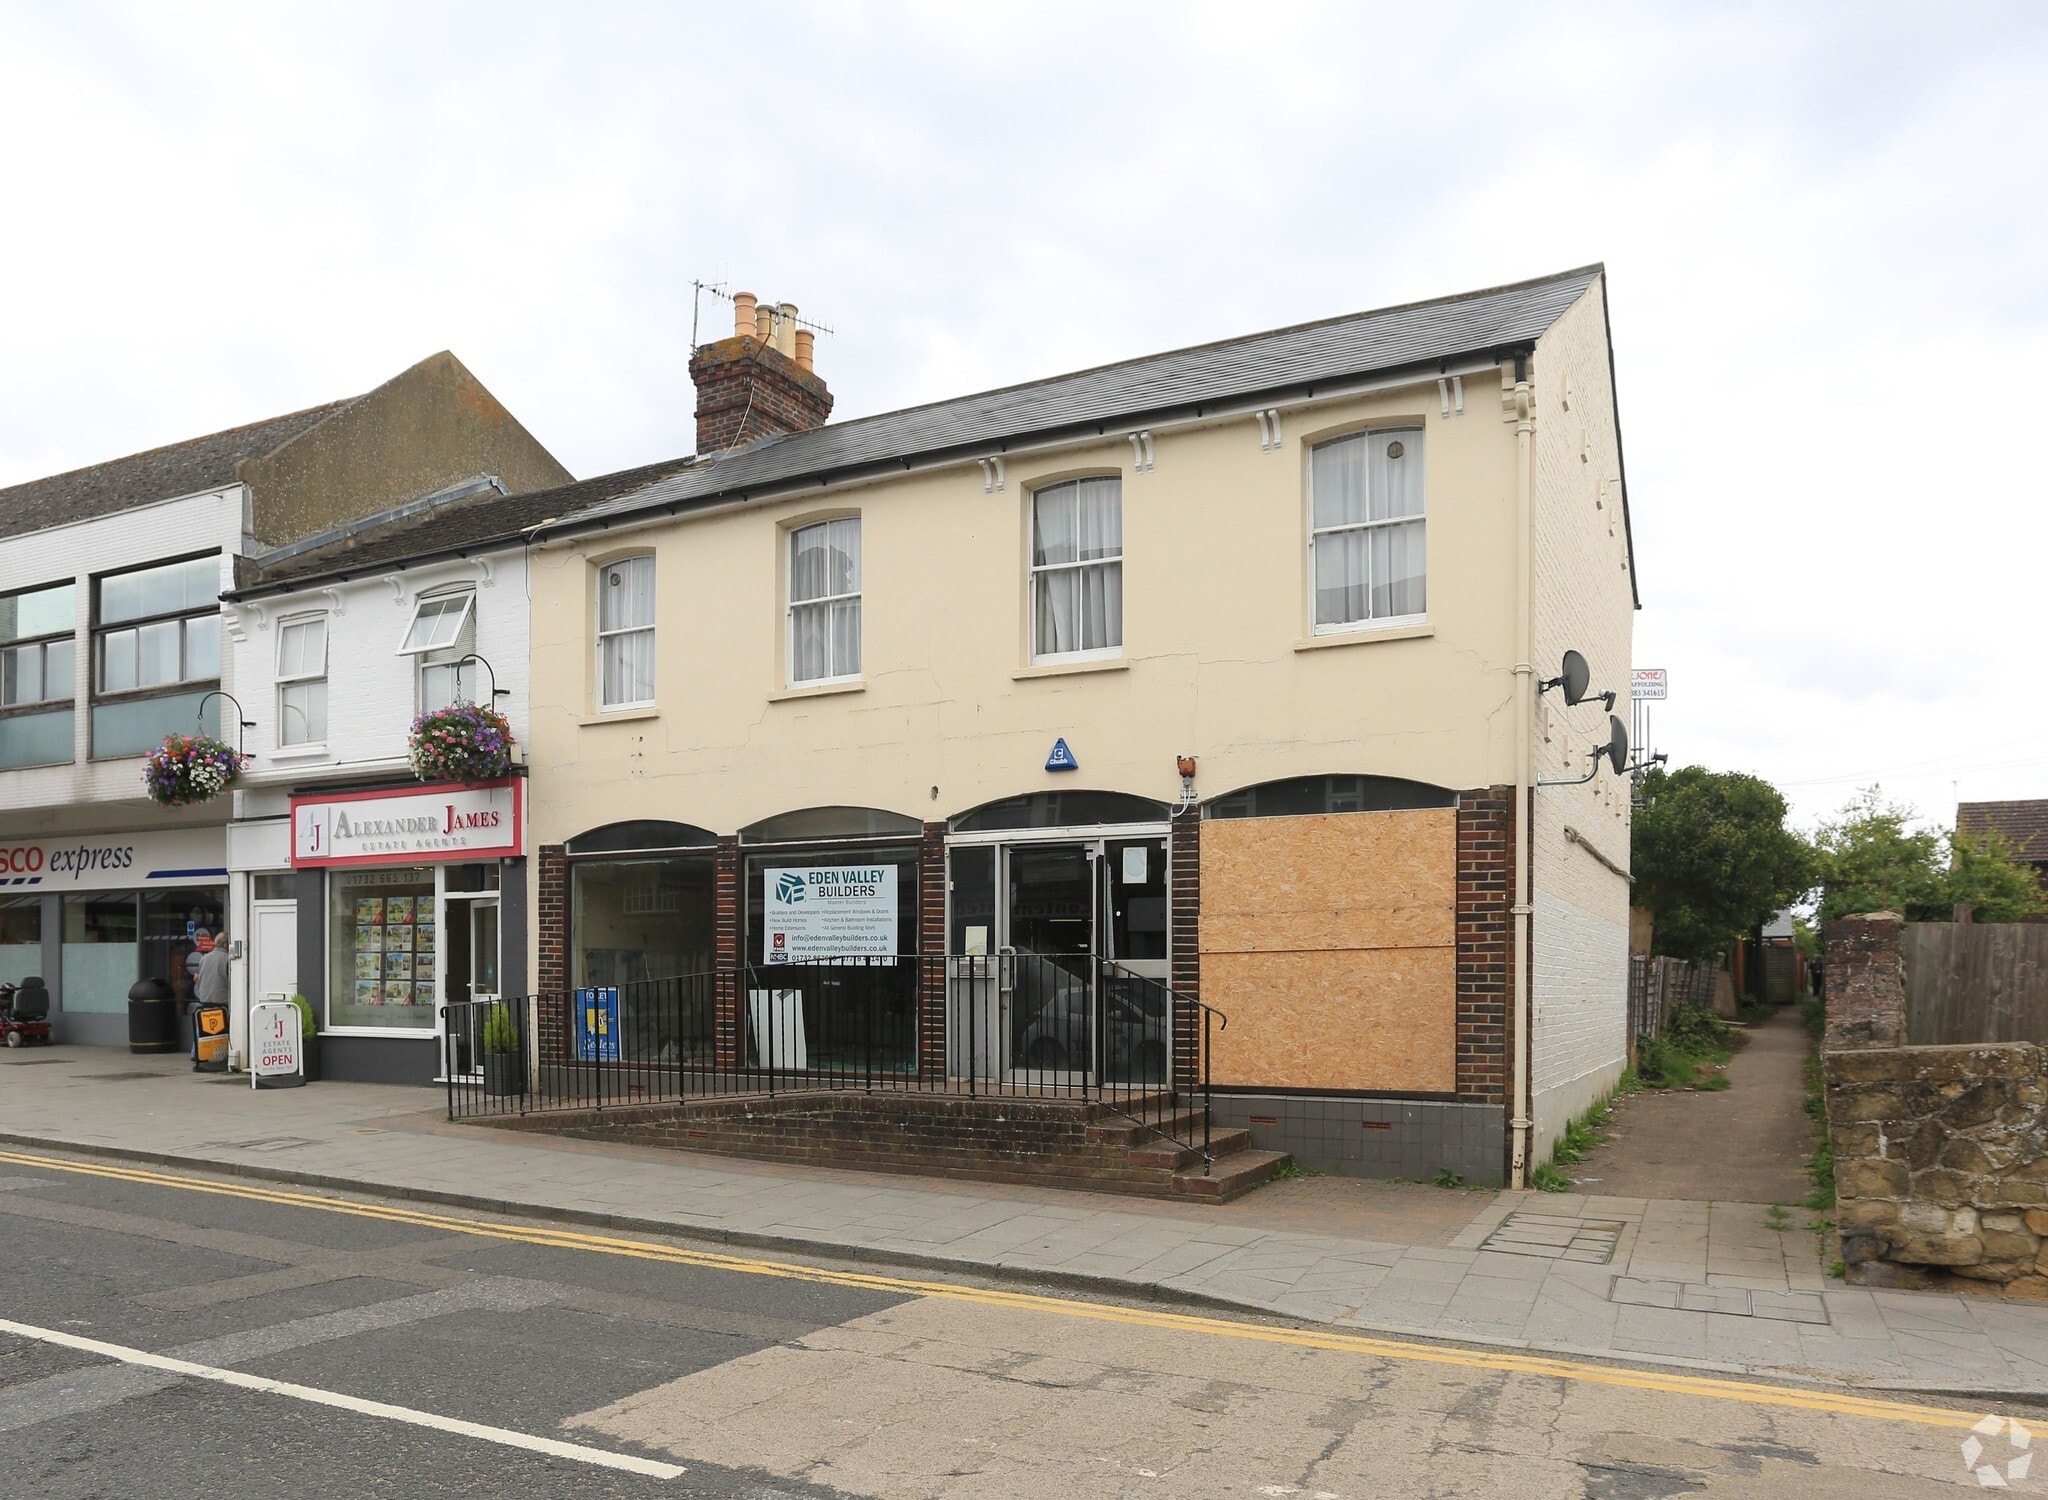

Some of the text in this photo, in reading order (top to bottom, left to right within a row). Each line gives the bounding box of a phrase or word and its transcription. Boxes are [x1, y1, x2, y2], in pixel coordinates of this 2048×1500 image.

[1642, 689, 1665, 697] 341615
[333, 804, 500, 839] ALEXANDER JAMES
[362, 836, 467, 851] ESTATE AGENTS
[0, 845, 133, 880] SCO express
[347, 874, 375, 885] 01732
[403, 872, 421, 882] 137
[808, 869, 885, 885] EDEN VALLEY
[818, 885, 876, 898] BUILDERS
[791, 934, 888, 943] info@edenvalleybuilders.co.uk
[791, 945, 888, 953] www.edenvalleybuilders.co.uk
[263, 1040, 290, 1048] ESTATE
[262, 1047, 293, 1055] AGENTS
[262, 1054, 293, 1067] OPEN
